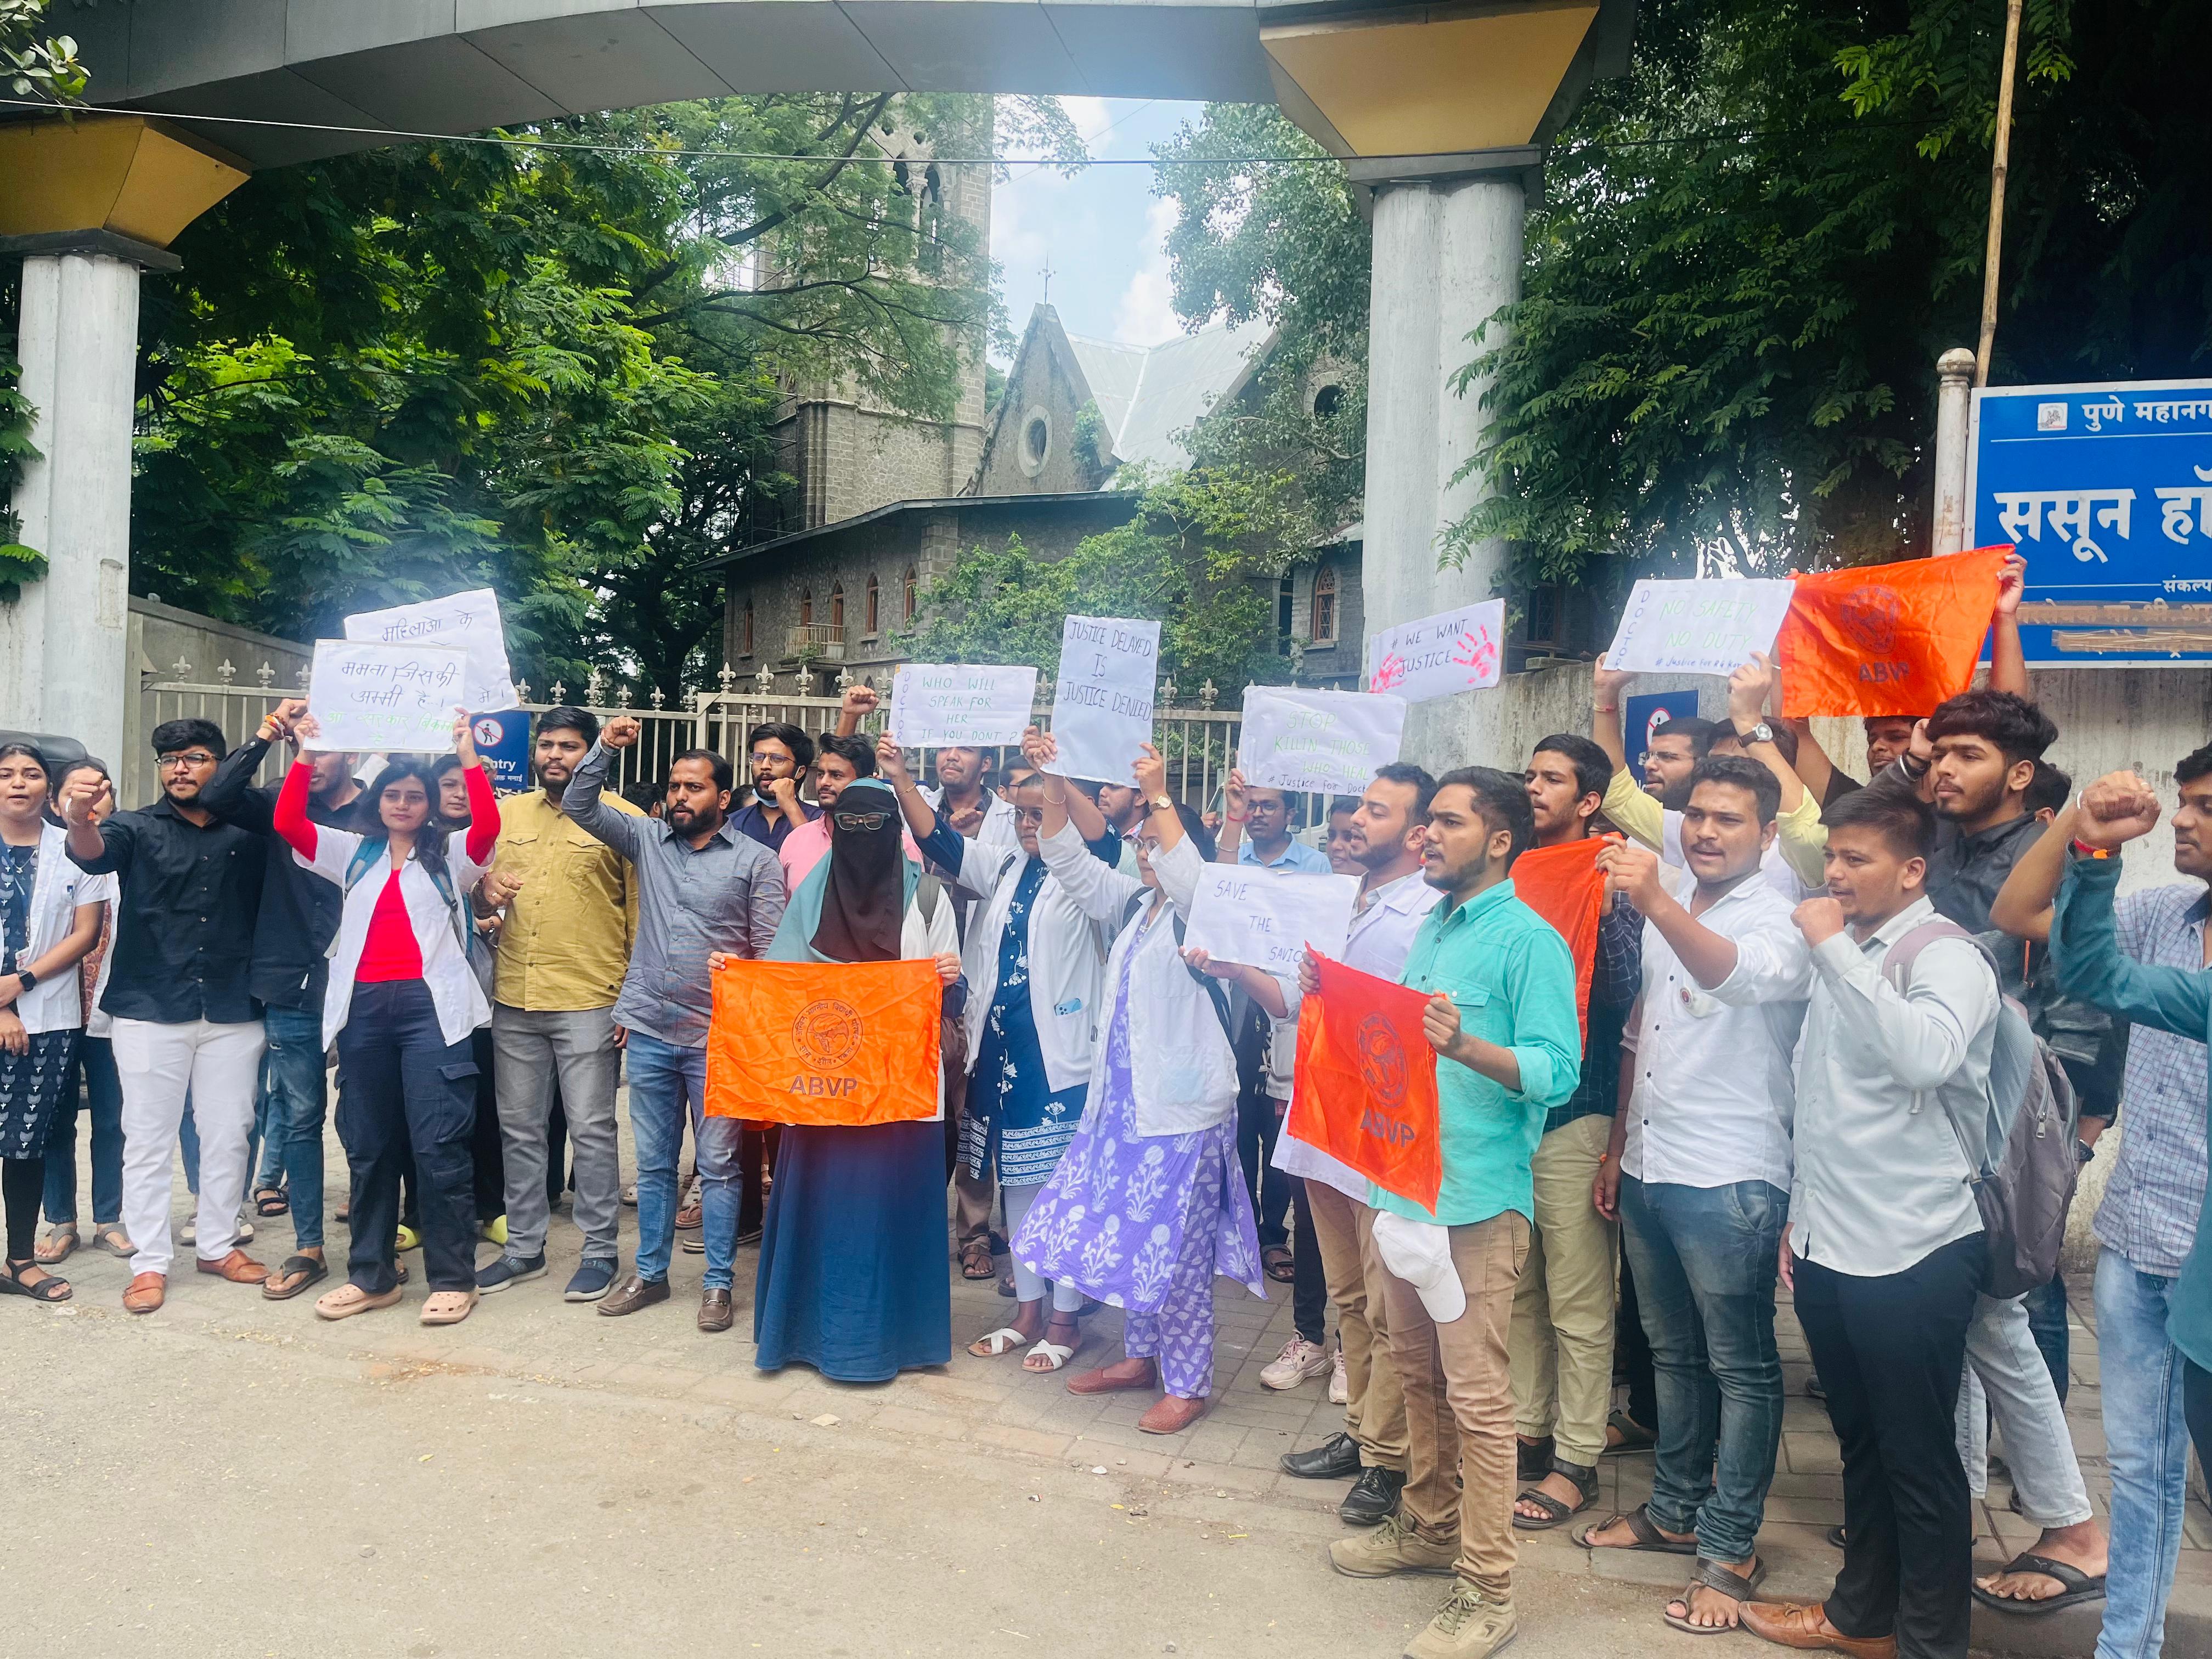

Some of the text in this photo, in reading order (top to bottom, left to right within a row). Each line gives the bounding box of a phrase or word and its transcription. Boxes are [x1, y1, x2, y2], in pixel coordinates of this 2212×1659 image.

[2081, 394, 2125, 432] पुणे
[1993, 488, 2137, 564] ससून
[454, 609, 478, 630] के
[1660, 600, 1759, 624] NO SAFETY
[1069, 622, 1152, 657] JUSTICE DELAYED
[1406, 631, 1422, 645] WE
[1436, 619, 1469, 639] WANT
[1665, 631, 1753, 651] NO DUTY
[342, 662, 389, 677] ममता
[1091, 653, 1108, 677] IS
[1398, 649, 1452, 678] JUSTICE
[1666, 656, 1696, 667] Justice
[1859, 661, 1909, 682] ABVP
[923, 677, 995, 691] WHO WILL
[351, 684, 404, 708] अम्मी
[928, 696, 992, 712] SPEAK FOR
[1063, 681, 1152, 721] JUSTICE DENIED
[896, 672, 911, 742] DOCTOR
[946, 714, 968, 724] HER
[1286, 710, 1336, 732] STOP
[922, 729, 1018, 744] IF YOU DONT ?
[1329, 740, 1371, 756] THOSE
[492, 759, 516, 772] ntry
[1302, 761, 1369, 781] WHO HEAL
[1278, 774, 1315, 788] Justice
[1347, 783, 1366, 794] Doct
[1214, 880, 1249, 901] SAVE
[1249, 916, 1272, 932] THE
[1268, 946, 1302, 962] SAVIO
[789, 1076, 857, 1096] ABVP
[1360, 1107, 1414, 1148] ABVP
